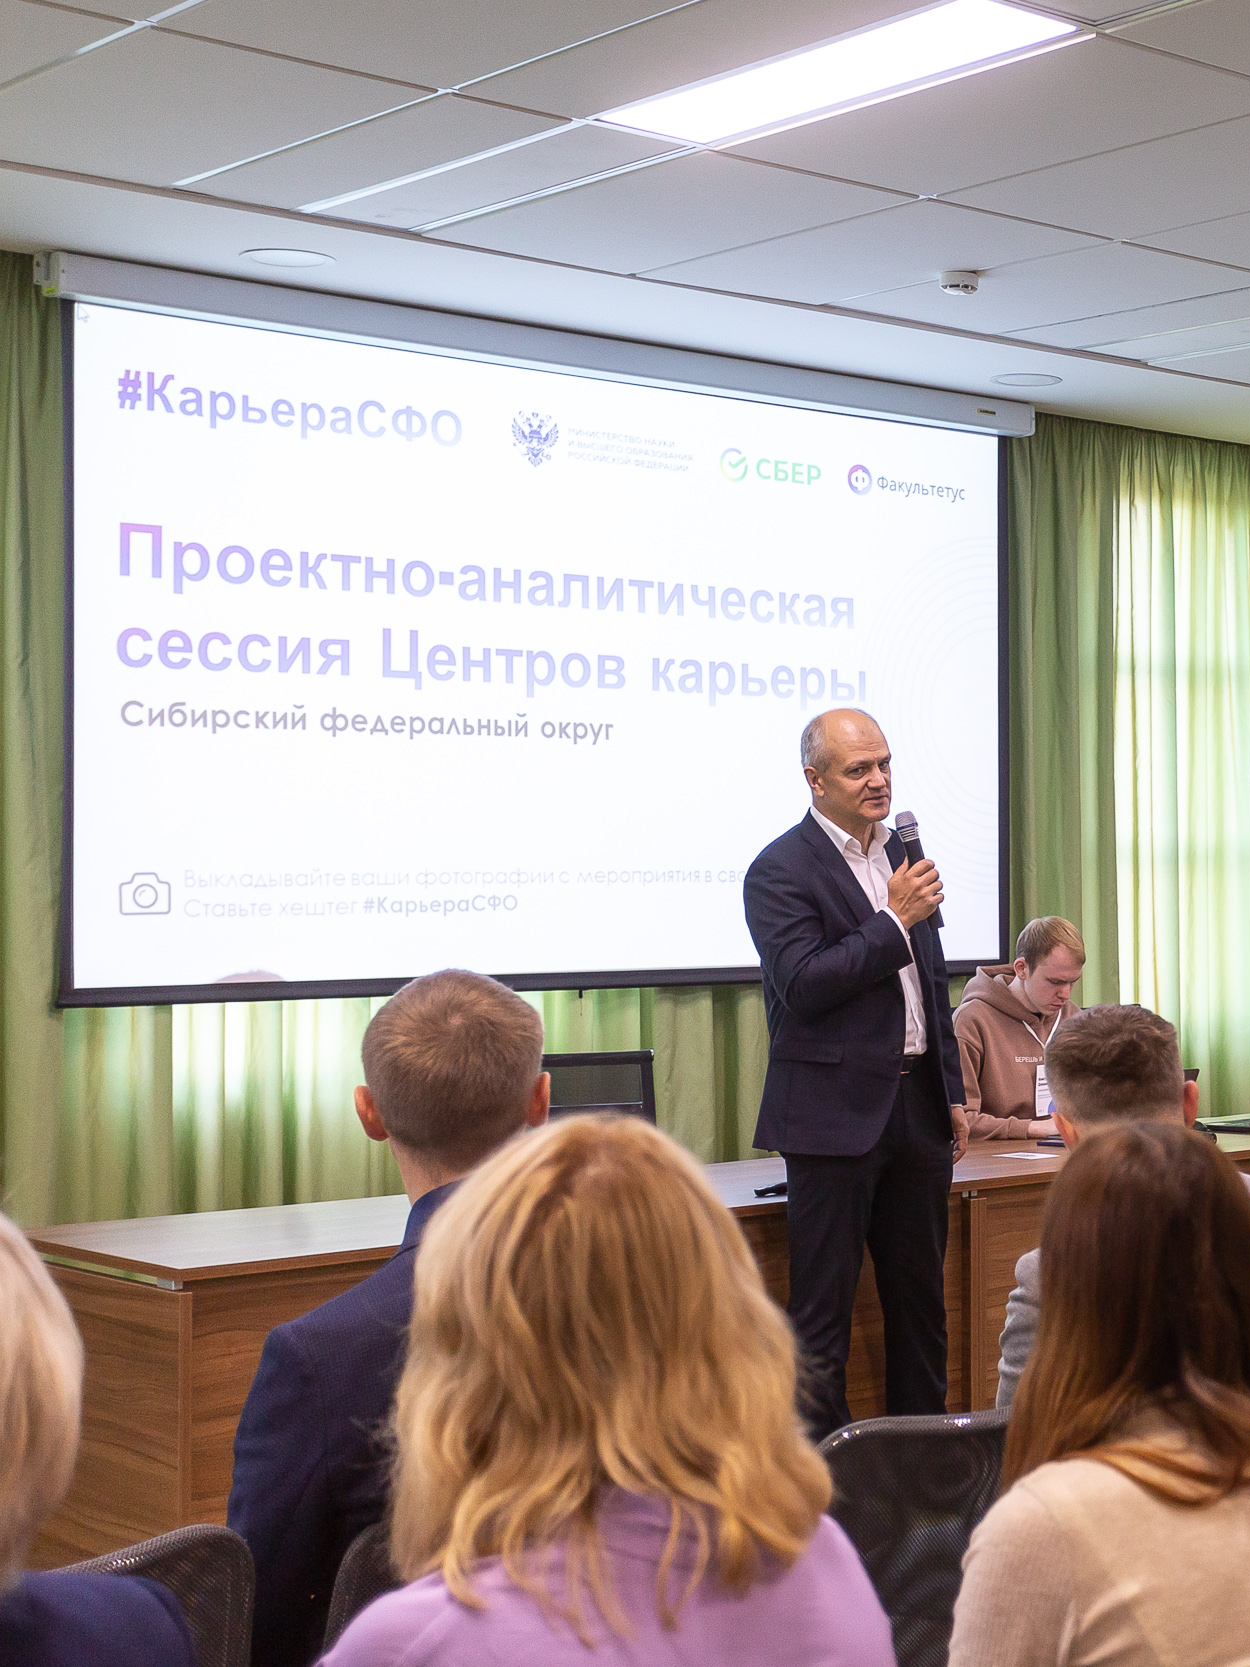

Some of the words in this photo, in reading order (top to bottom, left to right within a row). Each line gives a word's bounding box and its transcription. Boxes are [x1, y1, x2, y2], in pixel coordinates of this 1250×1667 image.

[116, 368, 463, 447] #КарьераСФО
[567, 427, 642, 445] МИНИСТЕРСТВО
[643, 438, 676, 449] НАУКИ
[576, 440, 624, 453] ВЫСШЕГО
[625, 446, 694, 462] ОБРАЗОВАНИЯ
[567, 450, 631, 466] РОССИЙСКОЙ
[632, 458, 690, 473] ФЕДЕРАЦИИ
[755, 457, 822, 486] СБЕР
[876, 475, 966, 503] Факультетус
[118, 521, 857, 631] Проектно-аналитическая
[115, 626, 351, 677] сессия
[381, 627, 627, 698] Центров
[650, 656, 867, 707] карьеры
[119, 699, 307, 735] Сибирский
[319, 704, 529, 741] федеральный
[540, 719, 614, 745] округ
[184, 867, 347, 890] Выкладывайте
[351, 870, 410, 887] ваши
[415, 867, 555, 890] фотографии
[558, 870, 570, 884] с
[576, 869, 701, 888] мероприятия
[704, 869, 713, 883] в
[717, 869, 746, 883] сво
[183, 898, 273, 918] Ставьте
[277, 899, 359, 917] хештег
[362, 894, 519, 918] #КарьераСФО
